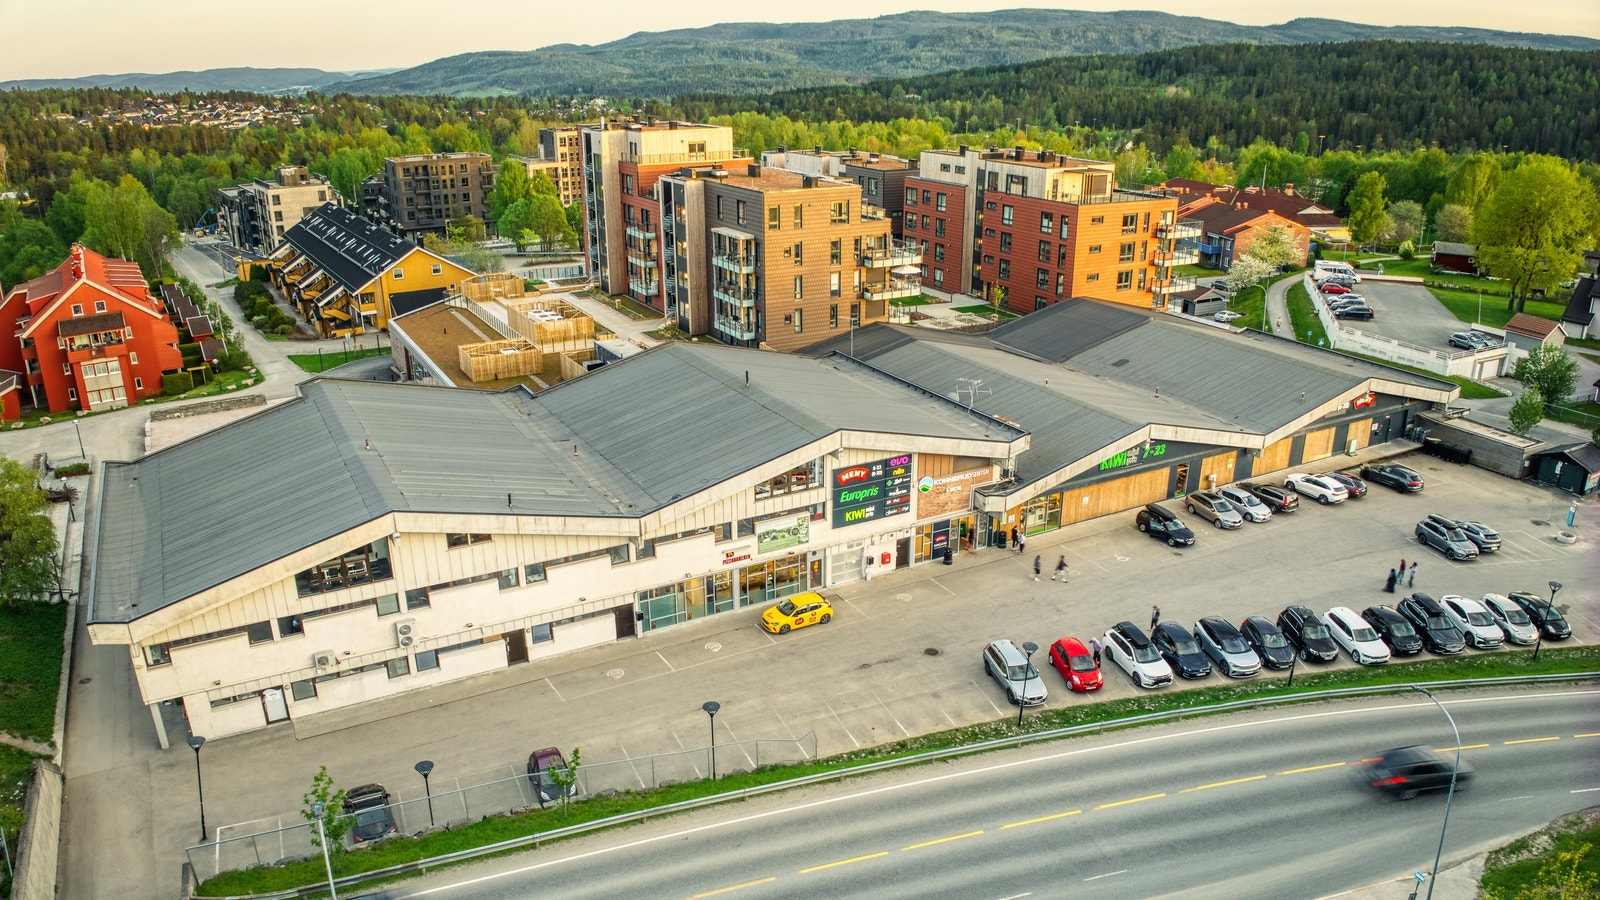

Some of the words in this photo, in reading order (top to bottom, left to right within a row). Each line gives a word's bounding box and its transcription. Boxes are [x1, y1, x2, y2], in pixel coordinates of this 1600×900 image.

[1143, 444, 1166, 458] 7-23
[890, 456, 908, 466] evo
[841, 470, 866, 481] MENY
[840, 485, 879, 502] Europris
[845, 509, 865, 522] KIWI
